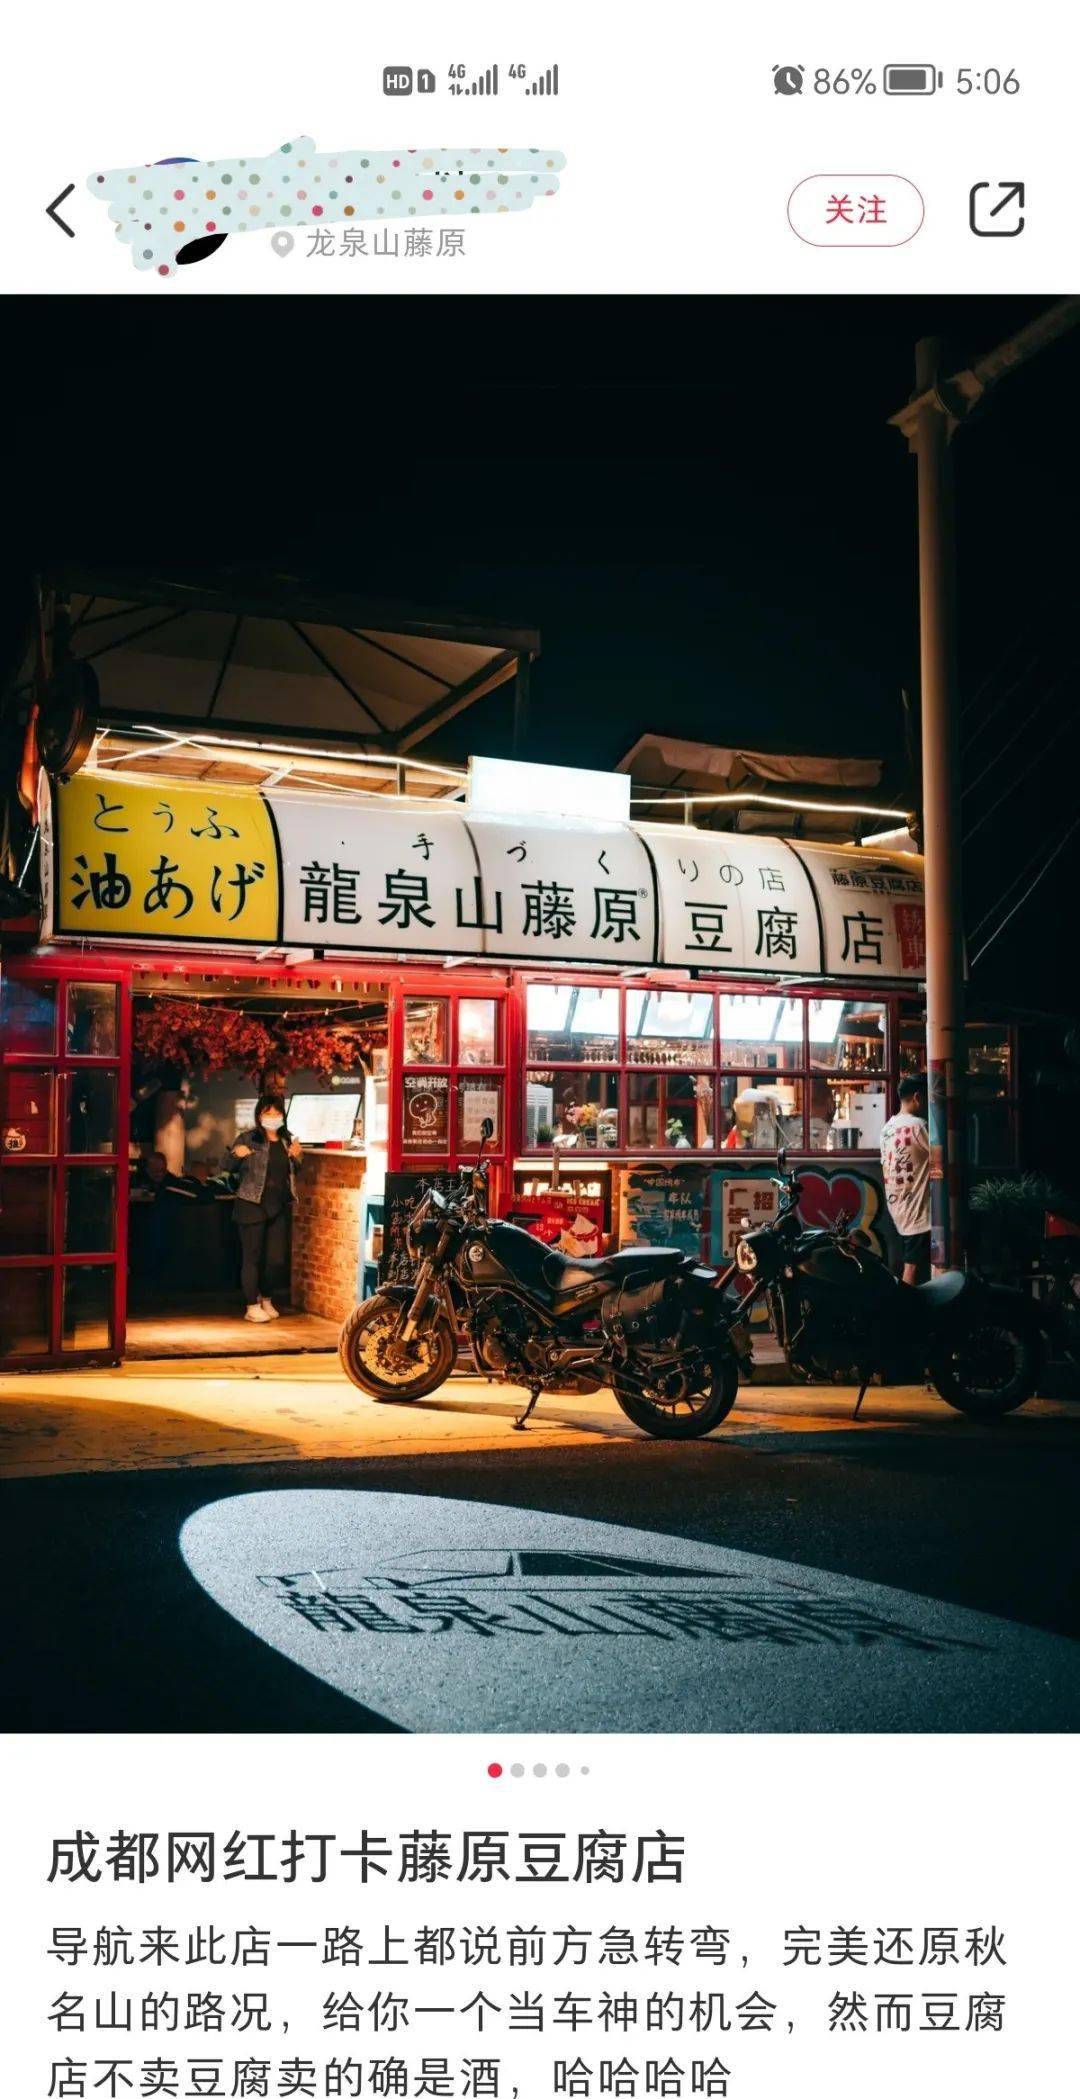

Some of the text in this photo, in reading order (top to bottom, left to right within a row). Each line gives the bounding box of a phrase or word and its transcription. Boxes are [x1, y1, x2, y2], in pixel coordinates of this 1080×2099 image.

[93, 793, 240, 840] とうふ
[70, 852, 266, 922] 油あげ
[276, 1590, 1000, 1652] 龍泉山藤原
